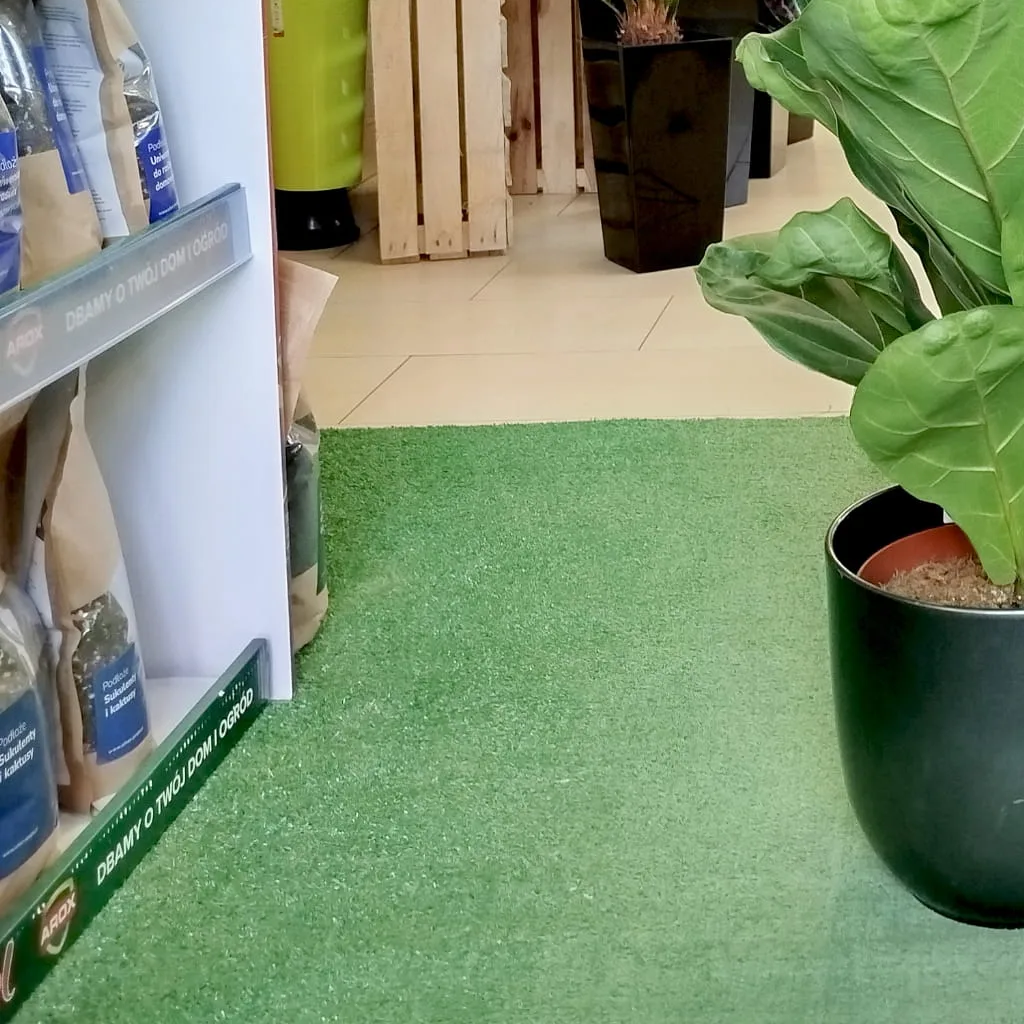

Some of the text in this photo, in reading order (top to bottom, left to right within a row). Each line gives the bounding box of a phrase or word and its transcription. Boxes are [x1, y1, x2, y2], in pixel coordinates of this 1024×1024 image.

[65, 290, 113, 332] DBAMY
[116, 283, 126, 304] O
[128, 261, 158, 296] TWÓJ
[160, 247, 186, 278] DOM
[104, 672, 137, 705] Sukulenty
[110, 687, 137, 714] kaktusy
[4, 747, 35, 779] kaktusy
[40, 687, 253, 947] AROX DBAMY O TWÓJ DOM I OGRÓD
